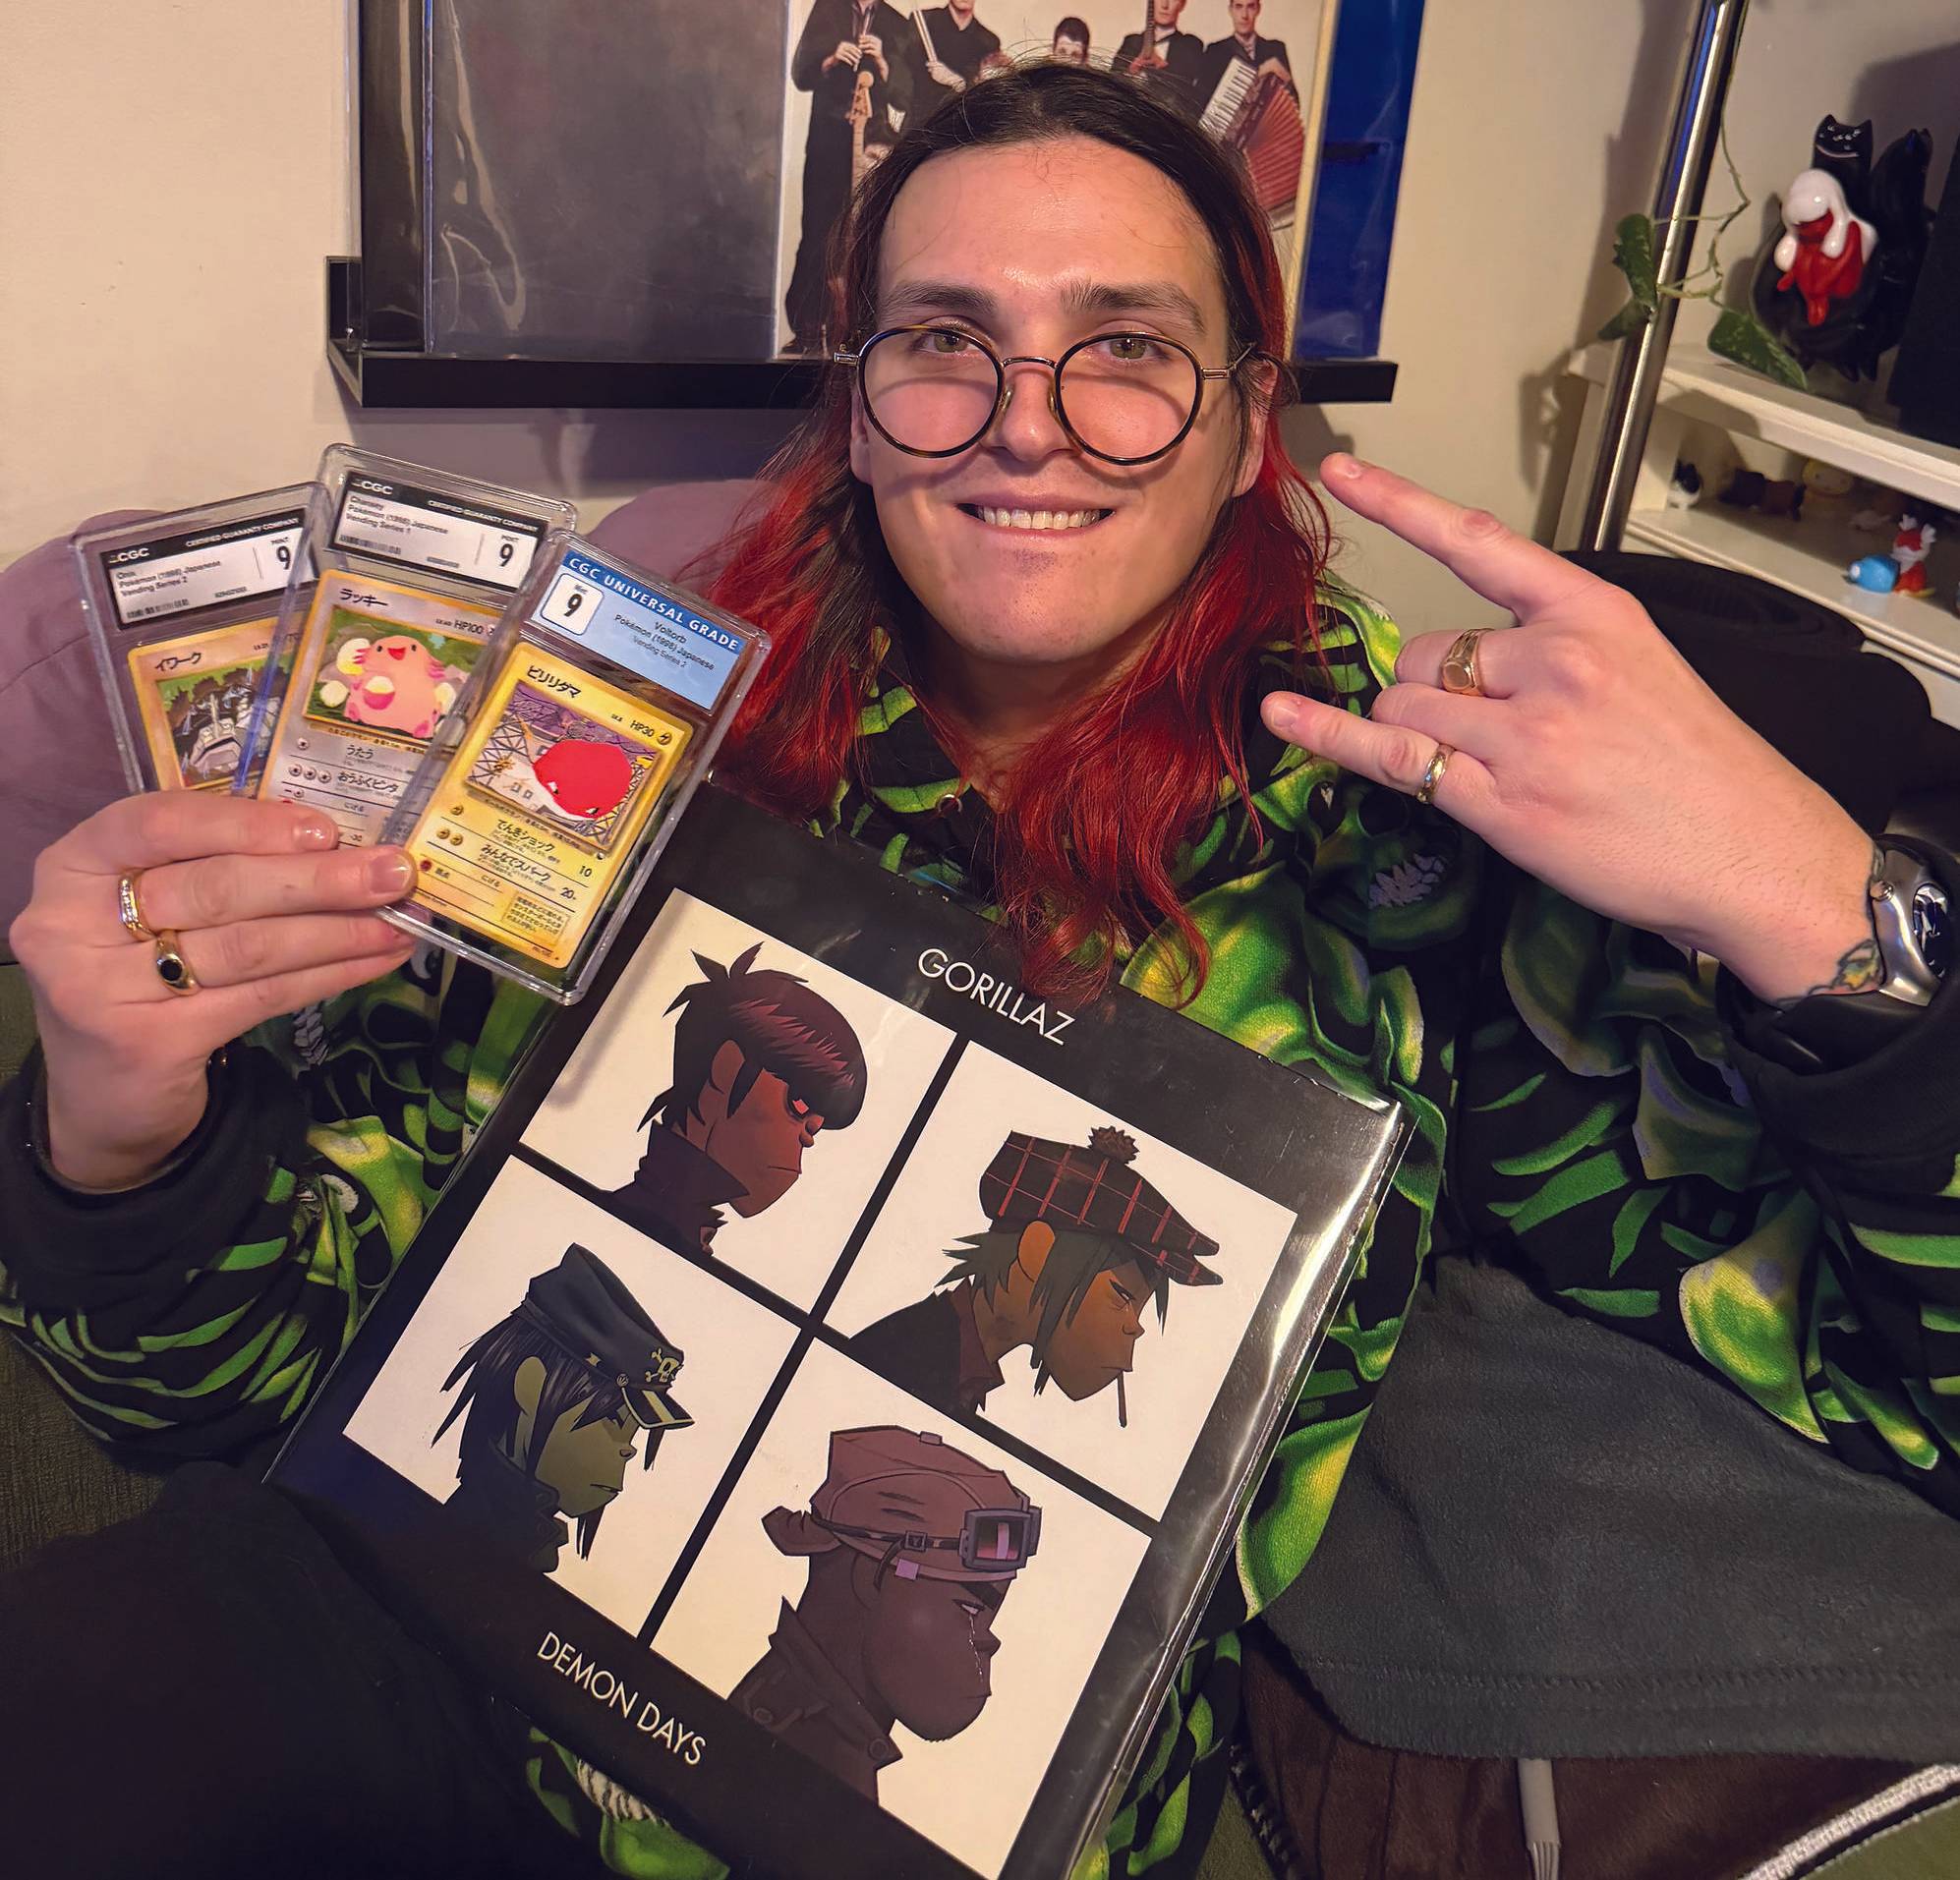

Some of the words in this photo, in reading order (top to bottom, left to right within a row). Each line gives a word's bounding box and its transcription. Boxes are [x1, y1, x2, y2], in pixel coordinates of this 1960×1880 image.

[361, 480, 394, 495] CGC
[116, 546, 150, 562] CGC
[275, 545, 291, 571] 9
[497, 542, 515, 568] 9
[339, 588, 388, 607] ラッキー
[563, 593, 583, 618] 9
[568, 557, 599, 580] CGC
[604, 573, 684, 624] UNIVERSAL
[688, 619, 739, 651] GRADE
[654, 621, 688, 645] Voltorb
[154, 652, 202, 672] イワーク
[677, 645, 716, 671] Japanese
[526, 664, 582, 699] ビリリダマ
[346, 745, 375, 760] うたう
[494, 818, 556, 854] でんきショック
[578, 865, 593, 878] 10
[918, 947, 1076, 1047] GORILLAZ
[537, 1630, 639, 1719] DEMON
[636, 1701, 707, 1765] DAYS
